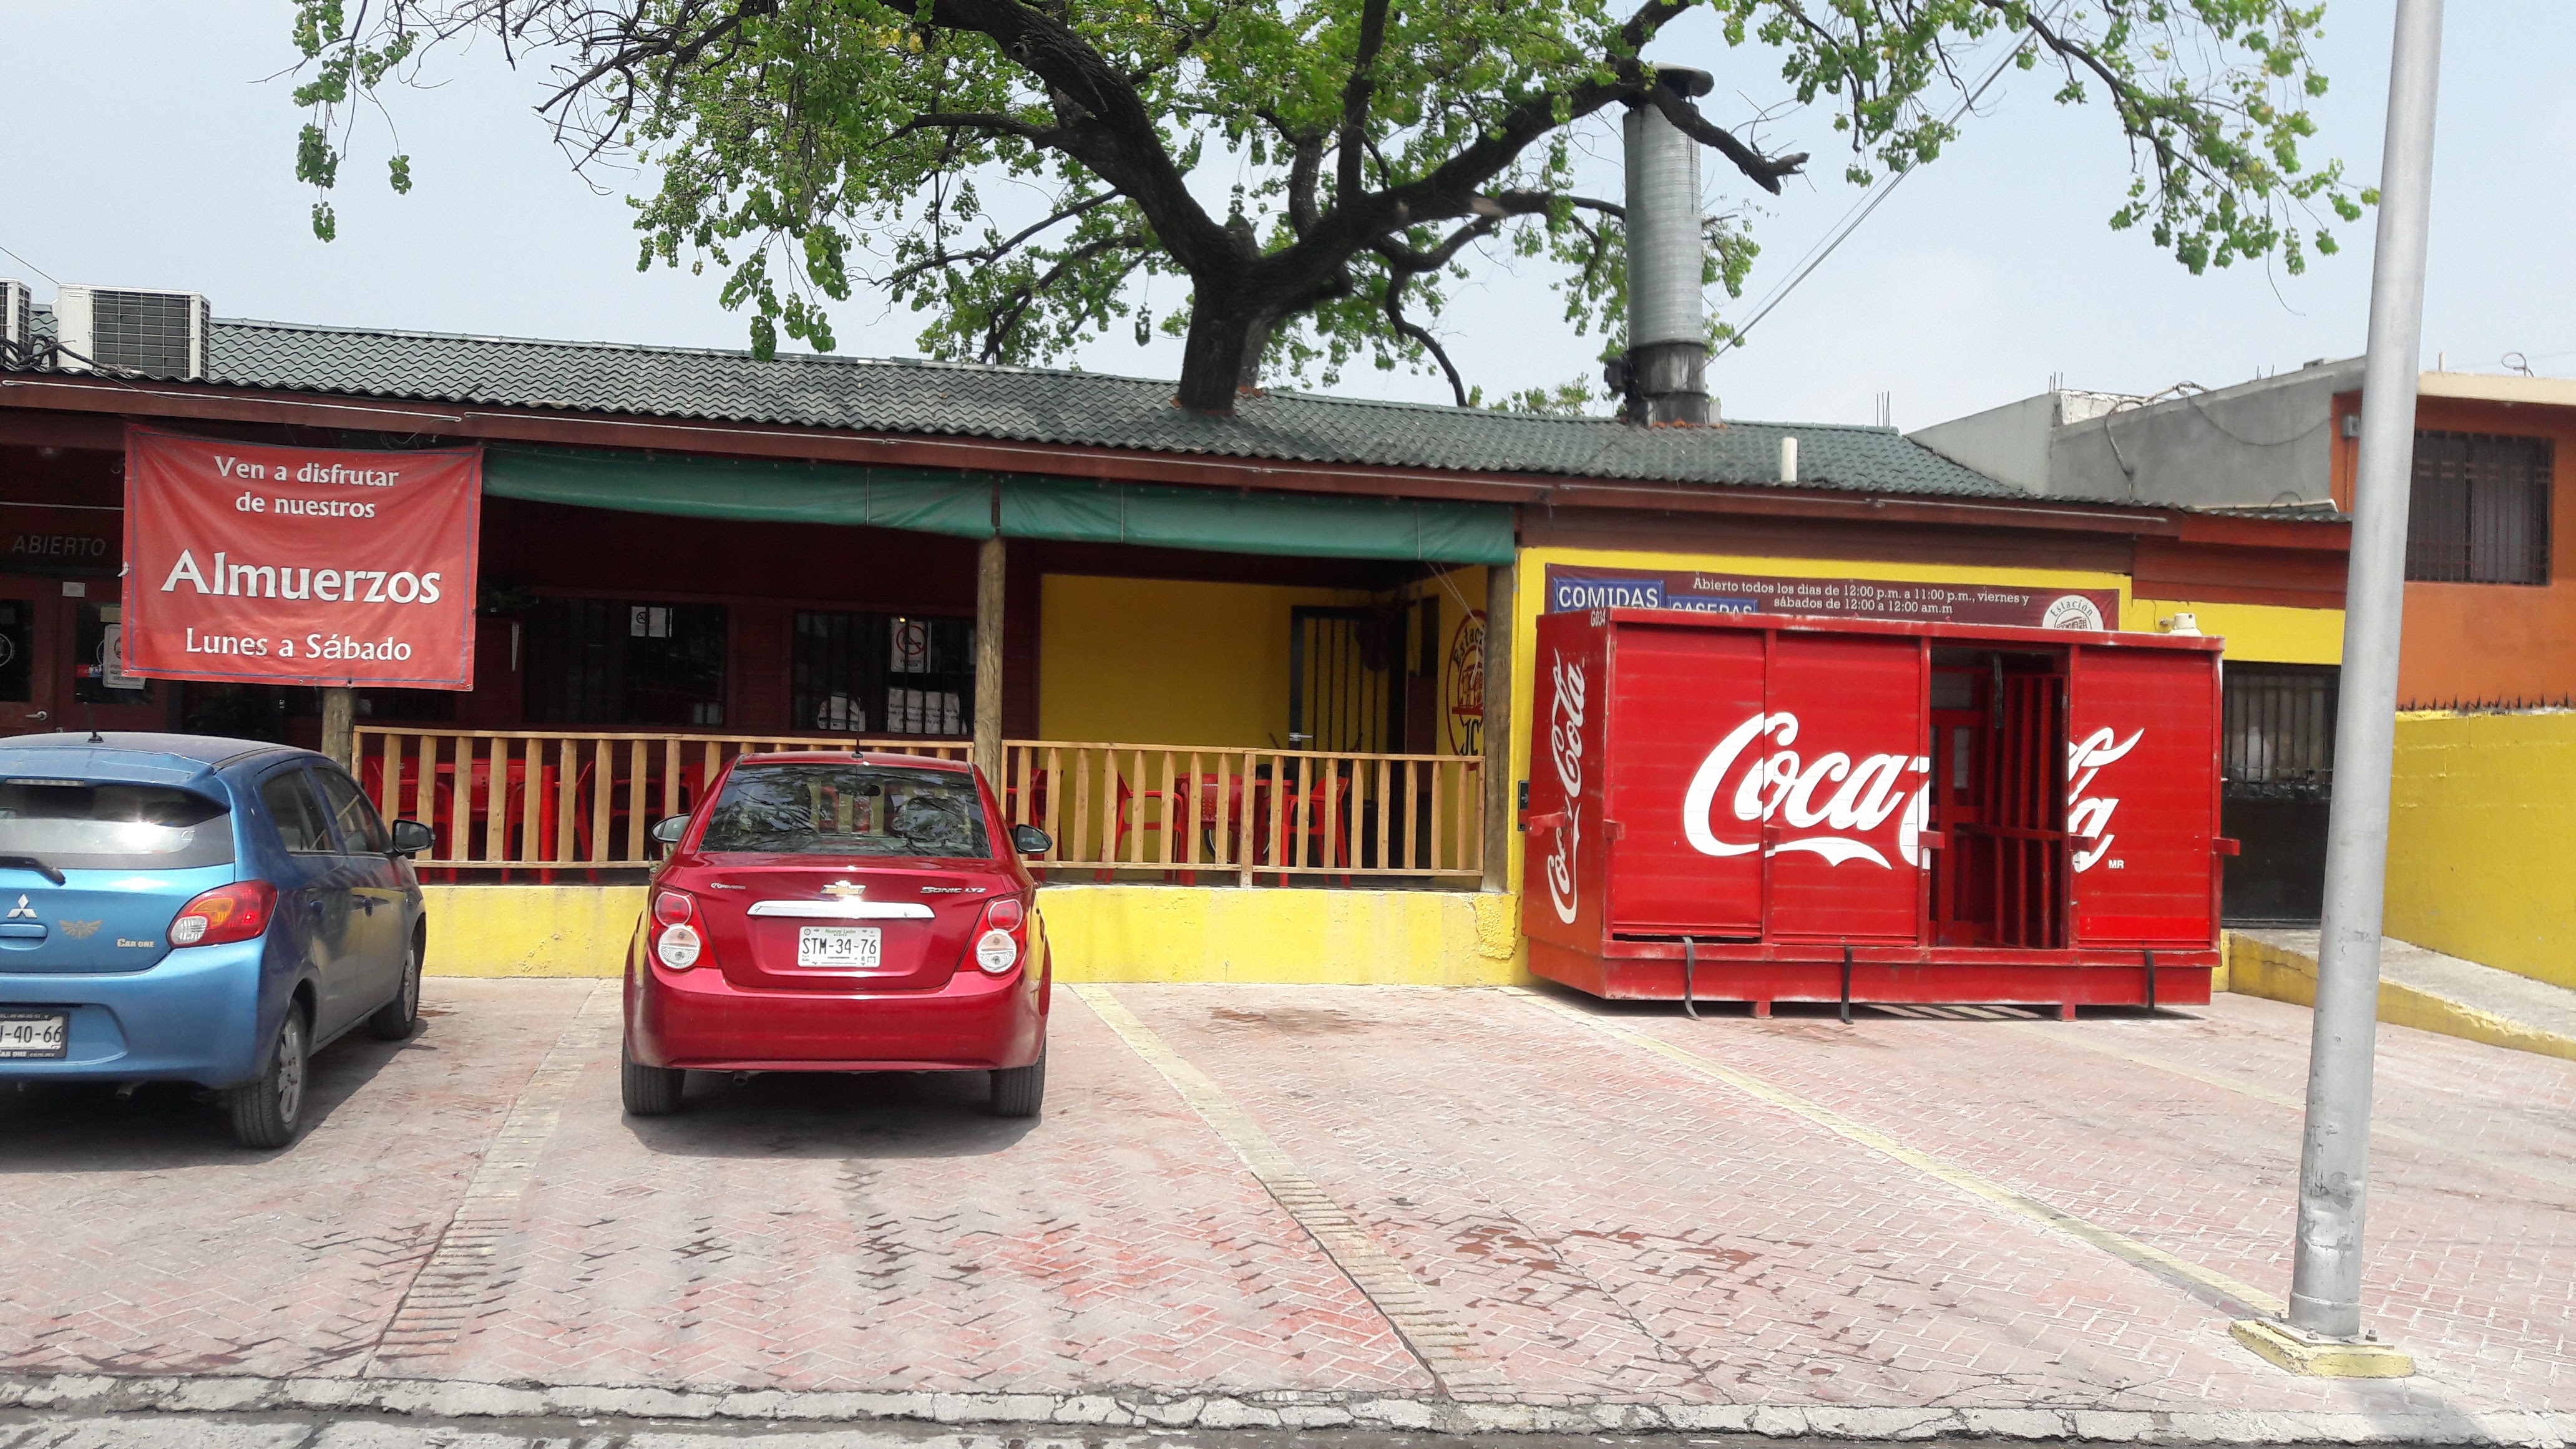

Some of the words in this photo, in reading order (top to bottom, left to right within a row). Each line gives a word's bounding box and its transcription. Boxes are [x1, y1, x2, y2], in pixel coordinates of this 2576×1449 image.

[214, 455, 265, 480] Ven
[274, 465, 287, 482] a
[296, 462, 399, 487] disfrutar
[236, 491, 265, 514] de
[275, 497, 376, 519] nuestros
[12, 535, 105, 556] ABIERTO
[160, 549, 442, 605] Almuerzos
[1559, 585, 1659, 610] COMIDAS
[1693, 578, 1739, 593] Abierto
[1742, 580, 1775, 593] todos
[1778, 582, 1795, 595] los
[1825, 585, 1840, 597] de
[1844, 585, 1874, 597] 12:00
[1876, 588, 1902, 600] p.m.
[1905, 590, 1911, 600] a
[1915, 588, 1945, 601] 11:00
[1978, 590, 2020, 603] viernes
[2022, 595, 2031, 607] y
[1774, 595, 1823, 609] sábados
[1826, 597, 1841, 610] de
[1845, 598, 1875, 611] 12:00
[1878, 602, 1885, 612] a
[1888, 600, 1919, 613] 12:00
[2050, 599, 2094, 617] Estación
[186, 627, 268, 657] Lunes
[279, 638, 293, 658] a
[305, 633, 412, 661] Sábado
[2109, 859, 2124, 869] MR
[802, 937, 877, 955] STM-34-76
